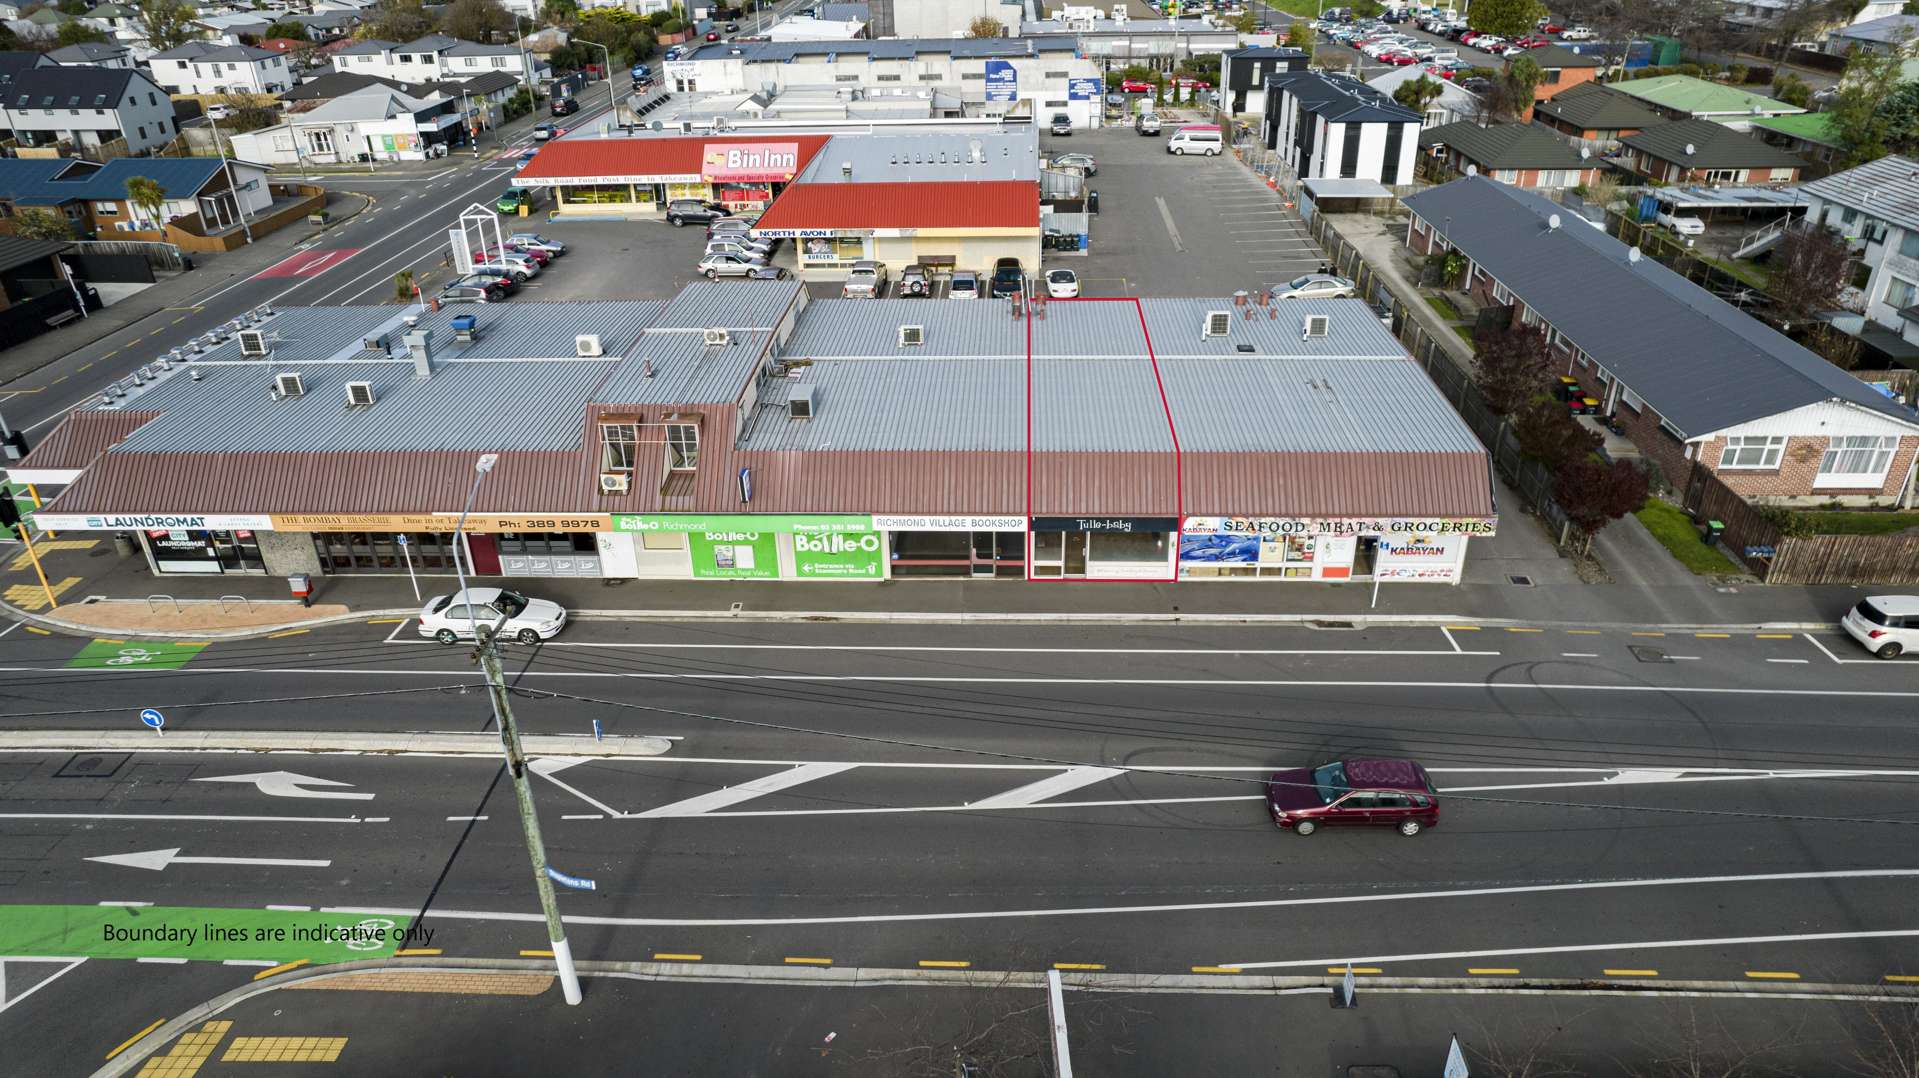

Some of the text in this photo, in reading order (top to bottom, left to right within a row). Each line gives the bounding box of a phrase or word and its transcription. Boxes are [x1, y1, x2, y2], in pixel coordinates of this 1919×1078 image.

[728, 148, 795, 169] Bin Inn
[103, 516, 205, 527] LAUNDROMAT
[281, 516, 300, 524] THE
[302, 516, 341, 524] BOMBAY
[402, 516, 423, 524] Dine
[876, 518, 1023, 528] RICHMOND VILLAGE BOOKSHOP
[662, 521, 706, 530] Richmond
[1319, 521, 1365, 534] MEAT
[1372, 521, 1384, 532] &
[1391, 521, 1493, 533] GROCERIES
[794, 534, 880, 553] Bottle-O
[1390, 546, 1445, 555] KABAYAN
